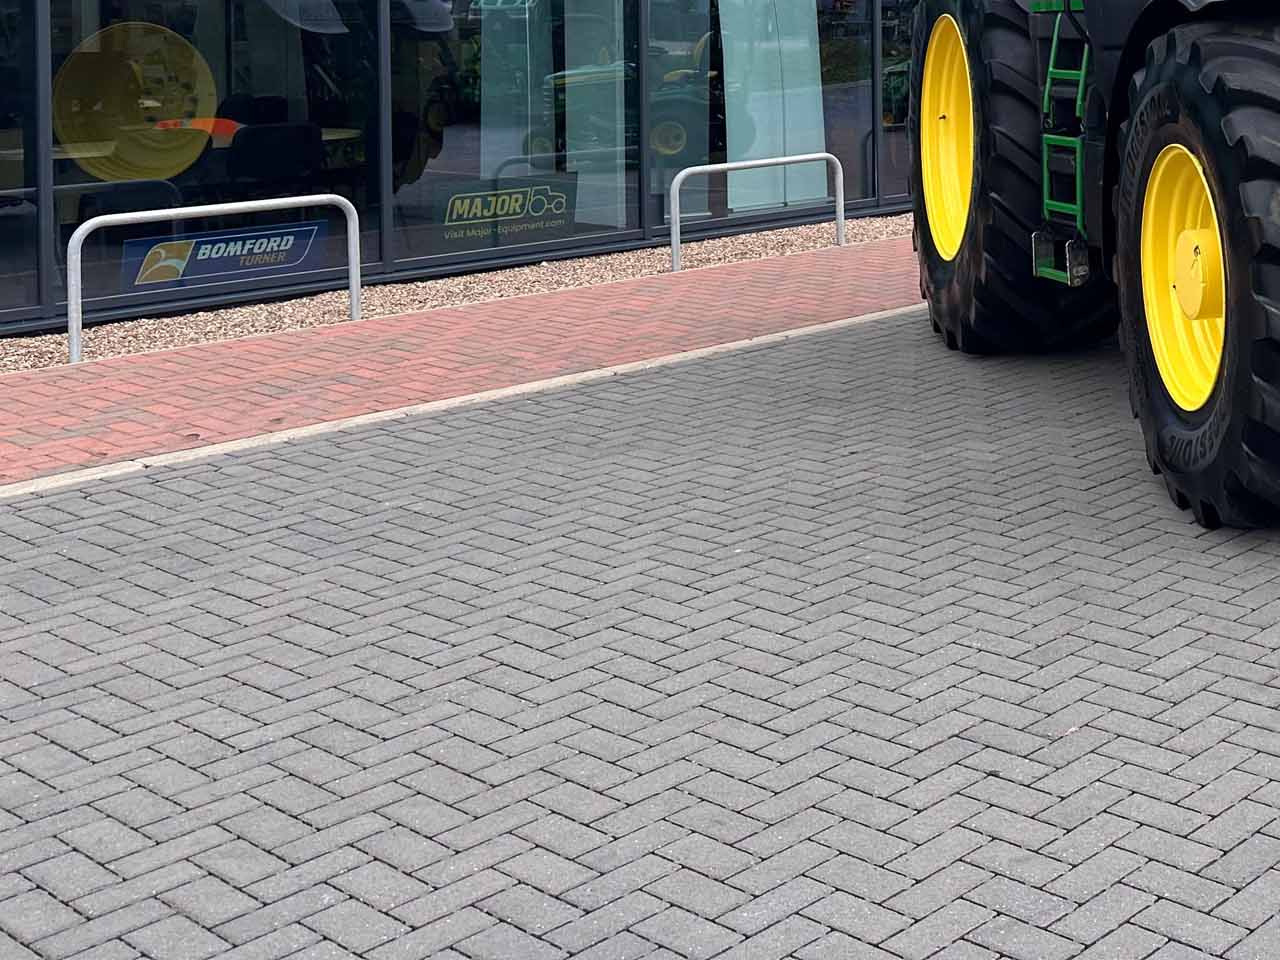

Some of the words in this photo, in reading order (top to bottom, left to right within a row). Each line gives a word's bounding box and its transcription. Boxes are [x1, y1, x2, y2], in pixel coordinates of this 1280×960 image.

[452, 193, 523, 219] MAJOR
[197, 235, 295, 260] BOMFORD
[239, 251, 287, 267] TURNER
